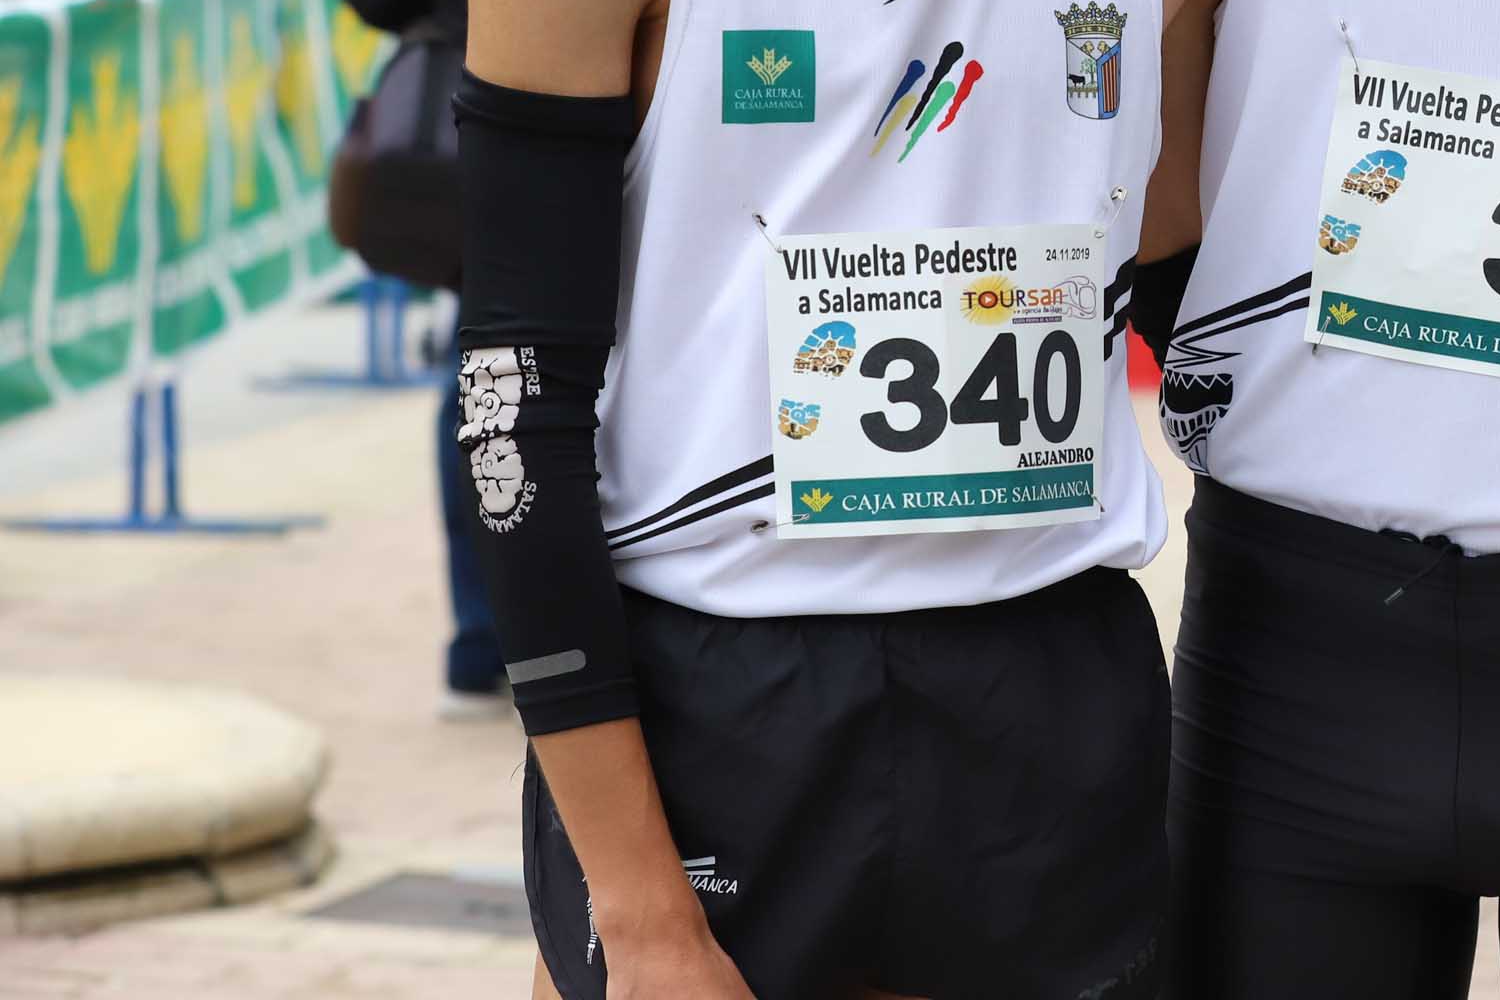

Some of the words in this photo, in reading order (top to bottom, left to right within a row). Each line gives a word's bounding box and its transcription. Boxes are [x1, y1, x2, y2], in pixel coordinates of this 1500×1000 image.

[735, 89, 763, 100] CAJA
[766, 88, 804, 98] RURAL
[735, 101, 745, 110] DE
[749, 101, 803, 110] SALAMANCA
[1354, 74, 1385, 108] VII
[1392, 80, 1467, 121] Vuelta
[1358, 122, 1369, 139] a
[1377, 119, 1495, 159] Salamanca
[783, 248, 816, 280] VII
[825, 241, 905, 278] Vuelta
[915, 240, 1017, 276] Pedestre
[1046, 248, 1090, 262] 24.11.2019
[799, 295, 811, 314] a
[818, 287, 942, 313] Salamanca
[1364, 315, 1411, 340] CAJA
[1419, 325, 1487, 351] RURAL
[860, 330, 1081, 452] 340
[1017, 447, 1094, 468] ALEJANDRO
[842, 494, 895, 515] CAJA
[902, 489, 974, 509] RURAL
[979, 487, 1008, 504] DE
[1012, 481, 1091, 502] SALAMANCA
